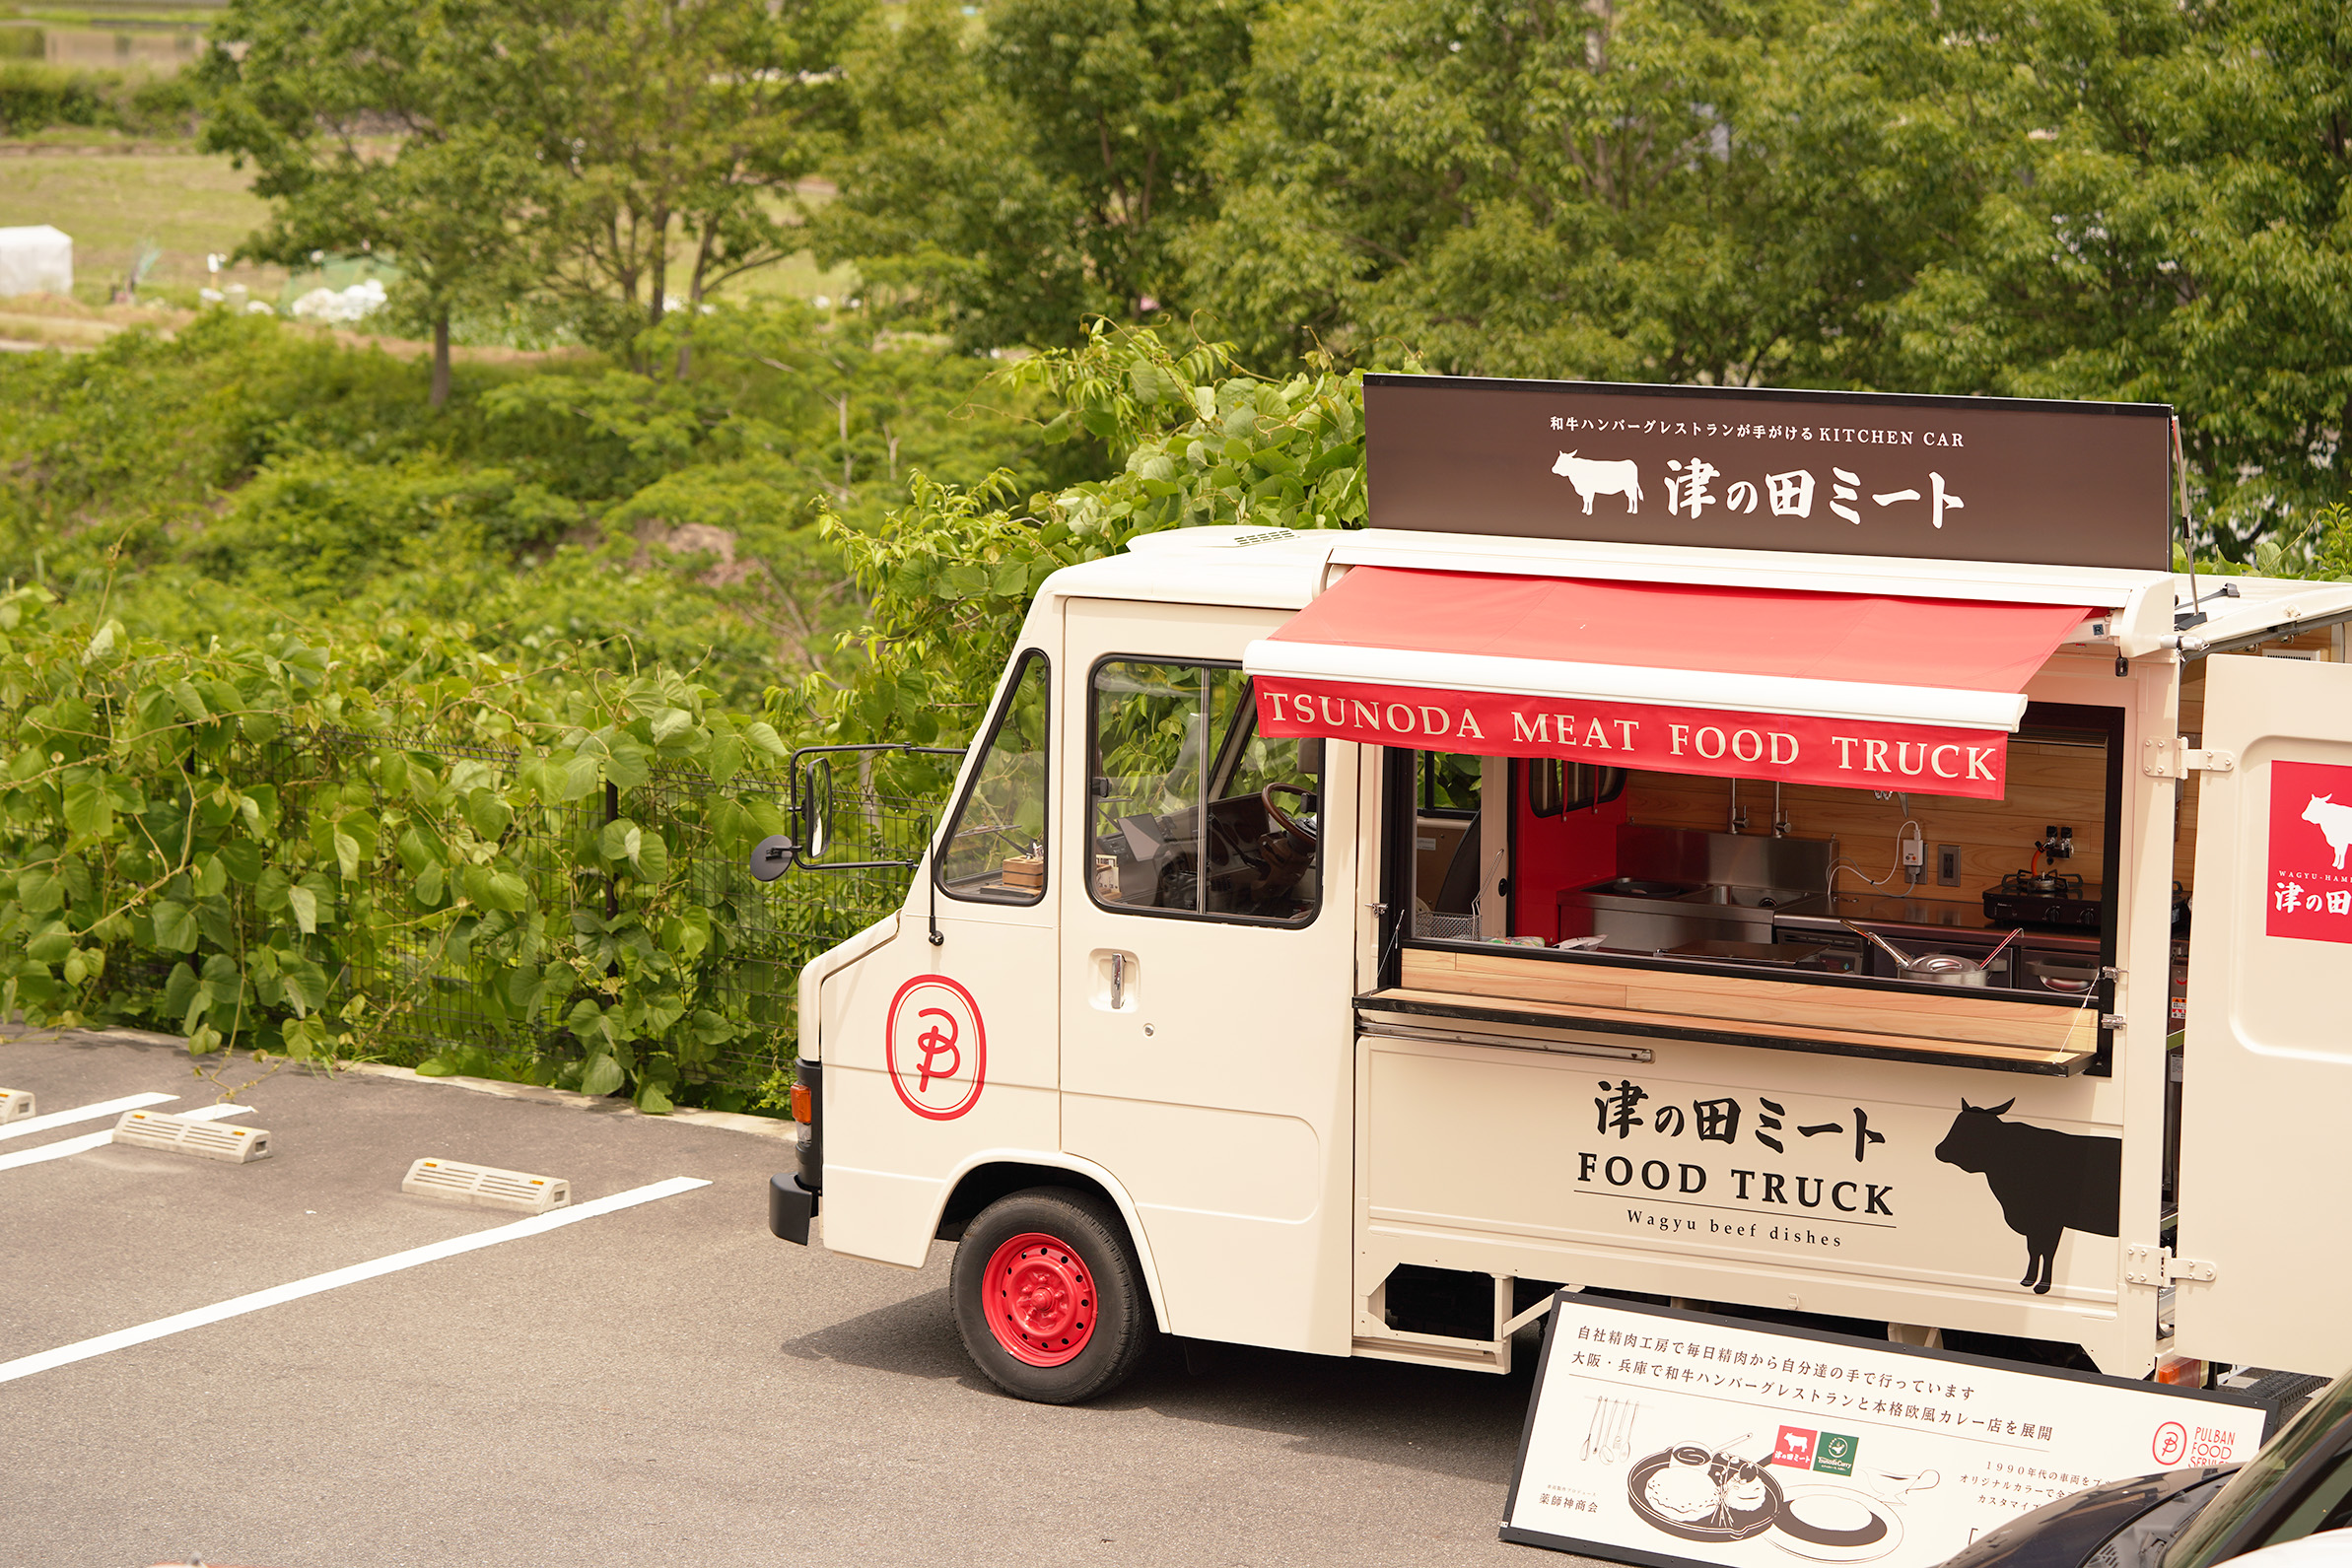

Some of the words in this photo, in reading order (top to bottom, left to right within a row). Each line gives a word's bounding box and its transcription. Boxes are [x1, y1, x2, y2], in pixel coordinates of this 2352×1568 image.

[1550, 415, 1814, 442] 和牛ハンバーグレストランが手がける
[1819, 427, 1914, 445] KITCHEN
[1923, 432, 1965, 447] CAR
[1663, 456, 1965, 529] 津の田ミート
[1263, 691, 1486, 740] TSUNODA
[1510, 711, 1640, 752] MEAT
[1668, 723, 1800, 766] FOOD
[1831, 735, 1997, 782] TRUCK
[2278, 869, 2352, 883] WAGYU-HAM
[2274, 881, 2352, 916] 津の田
[1594, 1079, 1886, 1163] 津の田ミート
[1577, 1151, 1708, 1194] FOOD
[1730, 1168, 1895, 1216] TRUCK
[1626, 1209, 1696, 1233] Wagyu
[1709, 1218, 1758, 1238] beef
[1769, 1226, 1842, 1248] dishes
[1577, 1325, 1975, 1401] 自社精肉工房で毎日精肉から自分達の手で行っています
[1570, 1350, 2053, 1442] 大阪・兵庫で和牛ハンバーグレストランと本格欧風カレー店を展開
[2191, 1442, 2232, 1460] FOOD
[2194, 1426, 2236, 1446] PULBAN
[1960, 1474, 2074, 1499] オリジナルカラーで全
[1986, 1461, 2111, 1487] 1990年代の車両をプ
